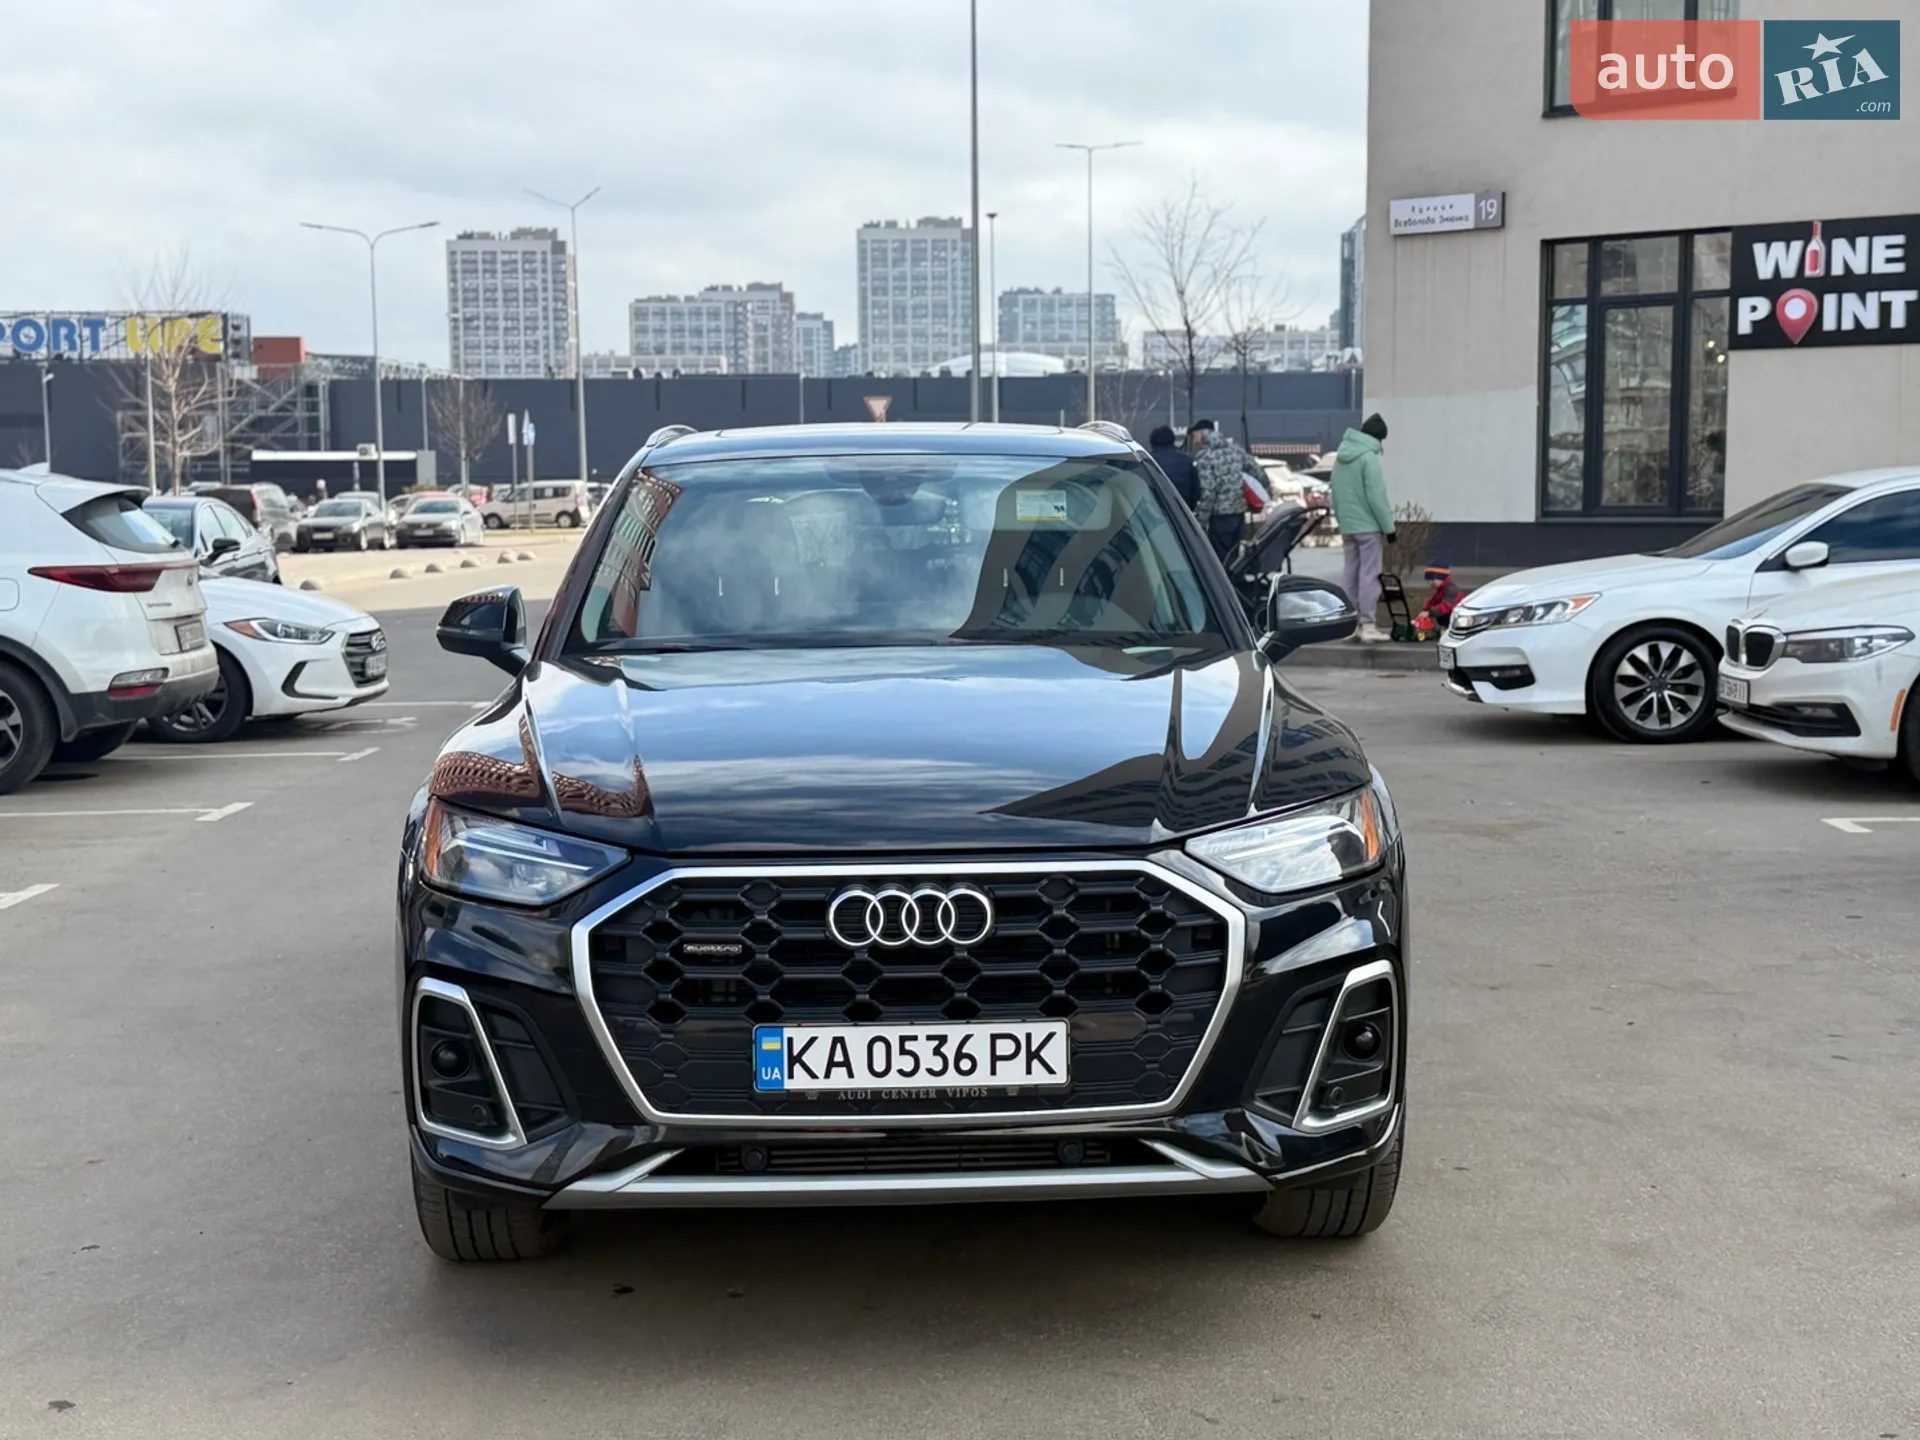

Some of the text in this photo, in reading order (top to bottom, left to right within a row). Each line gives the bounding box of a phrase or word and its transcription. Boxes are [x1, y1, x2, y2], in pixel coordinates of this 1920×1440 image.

[1478, 199, 1498, 220] 19
[1753, 221, 1907, 280] WINE
[1737, 288, 1918, 344] POINT
[0, 317, 106, 352] ORT
[761, 1067, 781, 1080] UA
[787, 1032, 1057, 1080] KA 0536 PK
[838, 1087, 988, 1100] AUDI CENTER VIPOS
